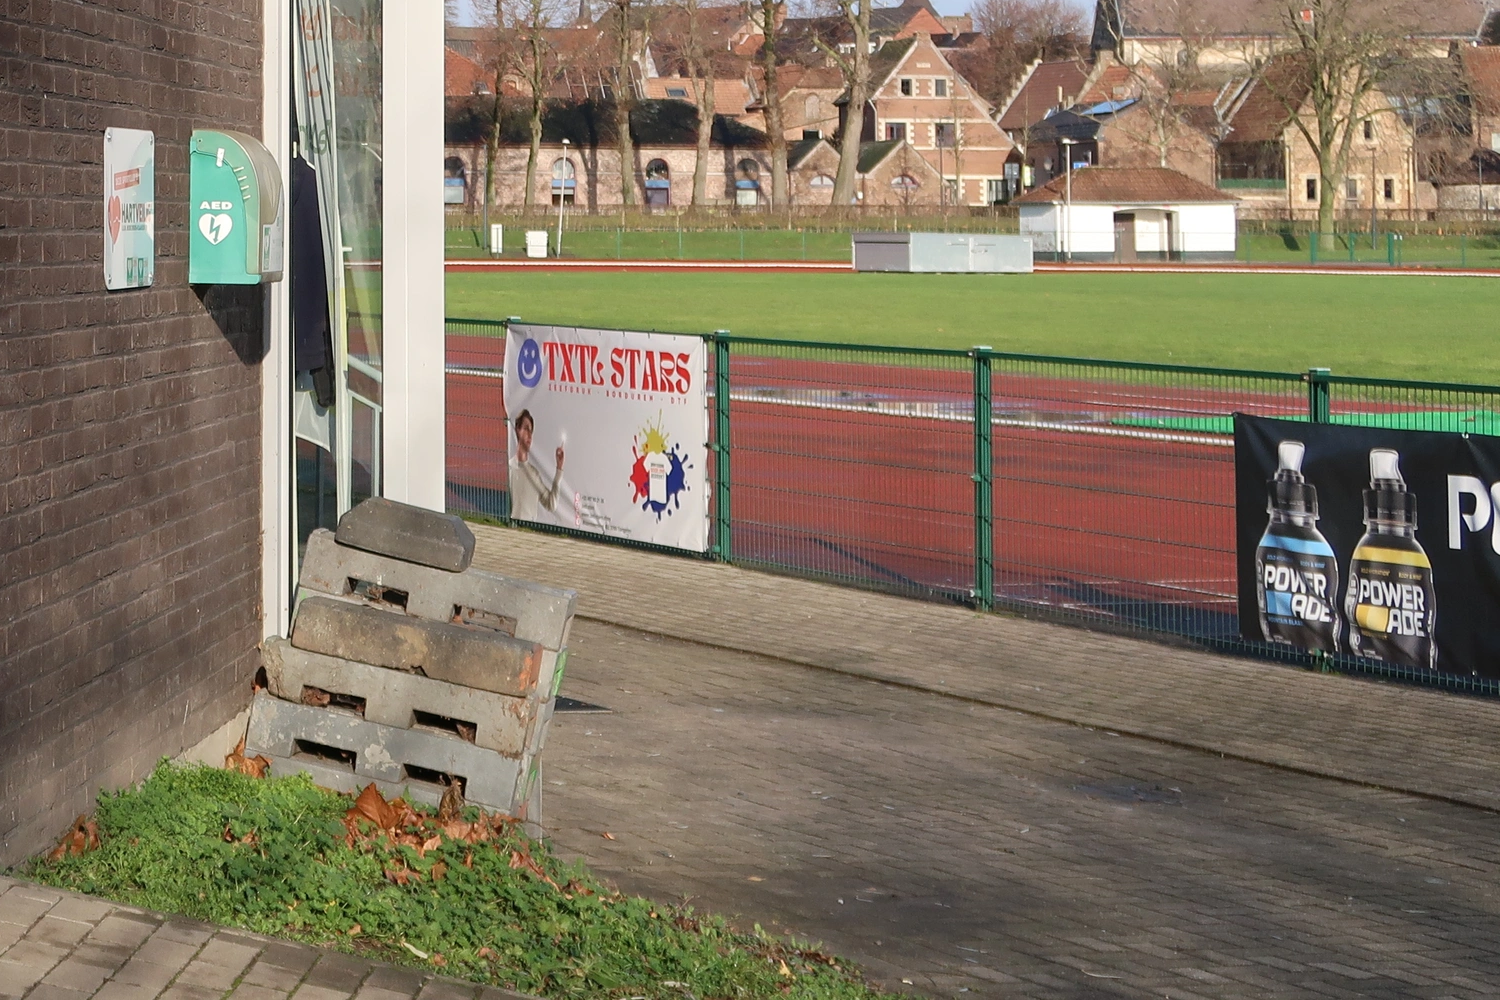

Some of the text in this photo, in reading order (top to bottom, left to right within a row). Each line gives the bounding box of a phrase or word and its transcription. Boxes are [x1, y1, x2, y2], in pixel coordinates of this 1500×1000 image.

[199, 201, 233, 210] AED
[610, 347, 692, 395] STARS
[548, 383, 592, 396] ZEEFDRUK
[606, 390, 654, 402] BORDUREN
[1446, 474, 1500, 556] P
[1264, 563, 1327, 599] POWER
[1358, 578, 1425, 612] POWER
[1291, 594, 1331, 623] ADE
[1386, 608, 1426, 638] ADE
